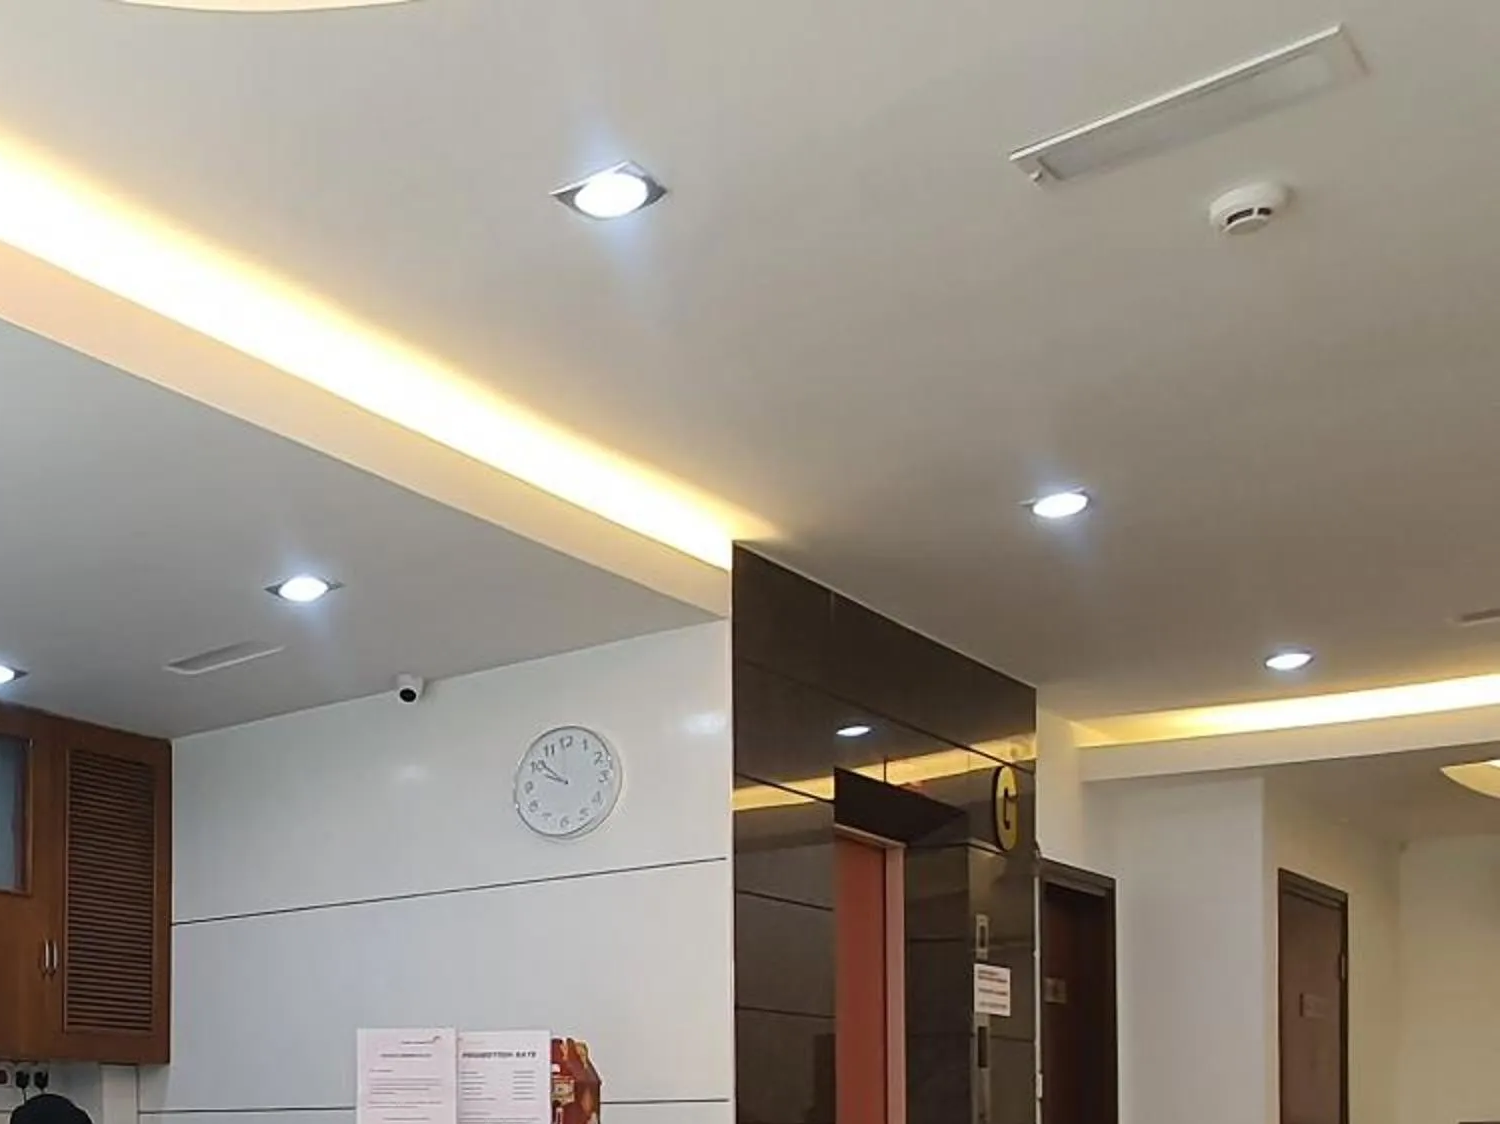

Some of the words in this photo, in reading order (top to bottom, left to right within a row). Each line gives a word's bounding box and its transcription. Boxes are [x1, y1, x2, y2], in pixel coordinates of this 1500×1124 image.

[559, 735, 573, 749] 12
[582, 738, 588, 751] 1
[543, 744, 555, 757] 11
[594, 751, 604, 765] 2
